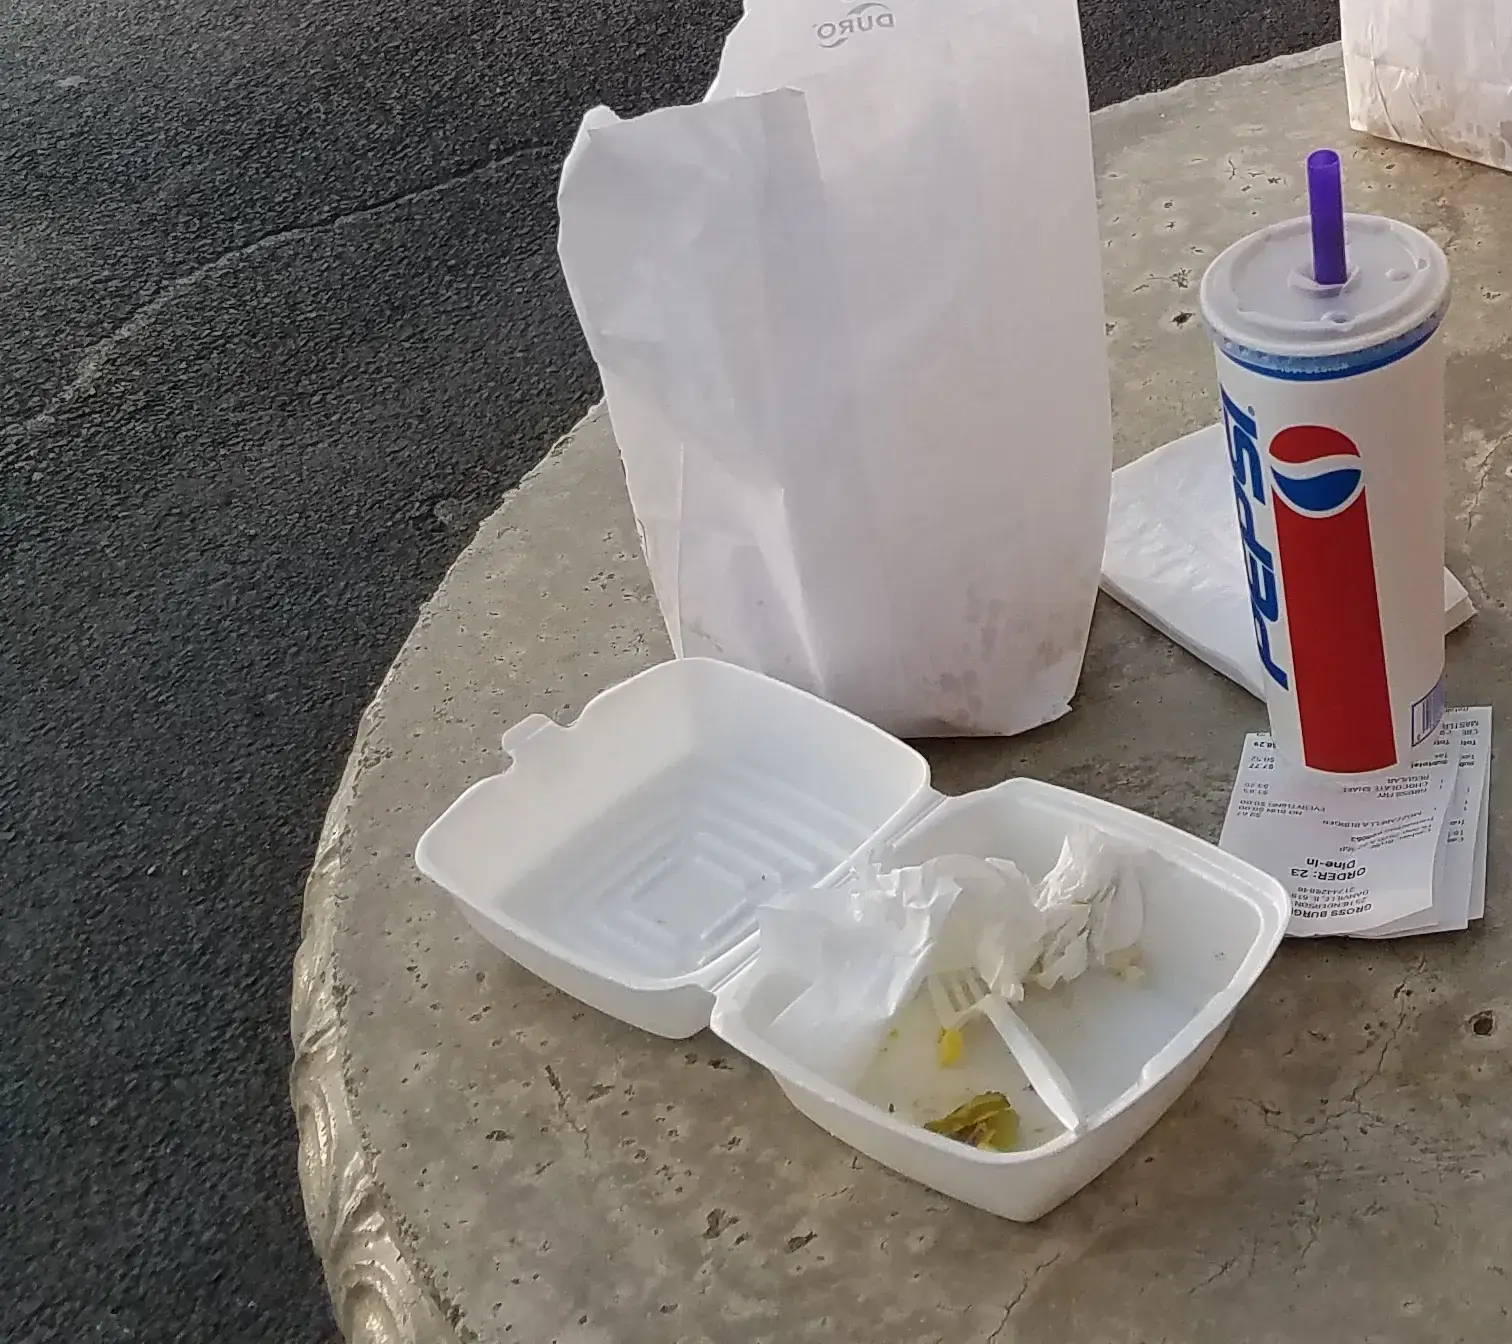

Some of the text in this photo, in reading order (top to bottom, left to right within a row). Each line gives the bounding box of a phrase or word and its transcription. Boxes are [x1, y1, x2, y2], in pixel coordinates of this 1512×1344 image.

[1220, 383, 1289, 691] PEPSI
[1306, 858, 1356, 870] Dine-In
[1291, 867, 1366, 881] ORDER: 23
[1291, 903, 1372, 918] GROSS BURG
